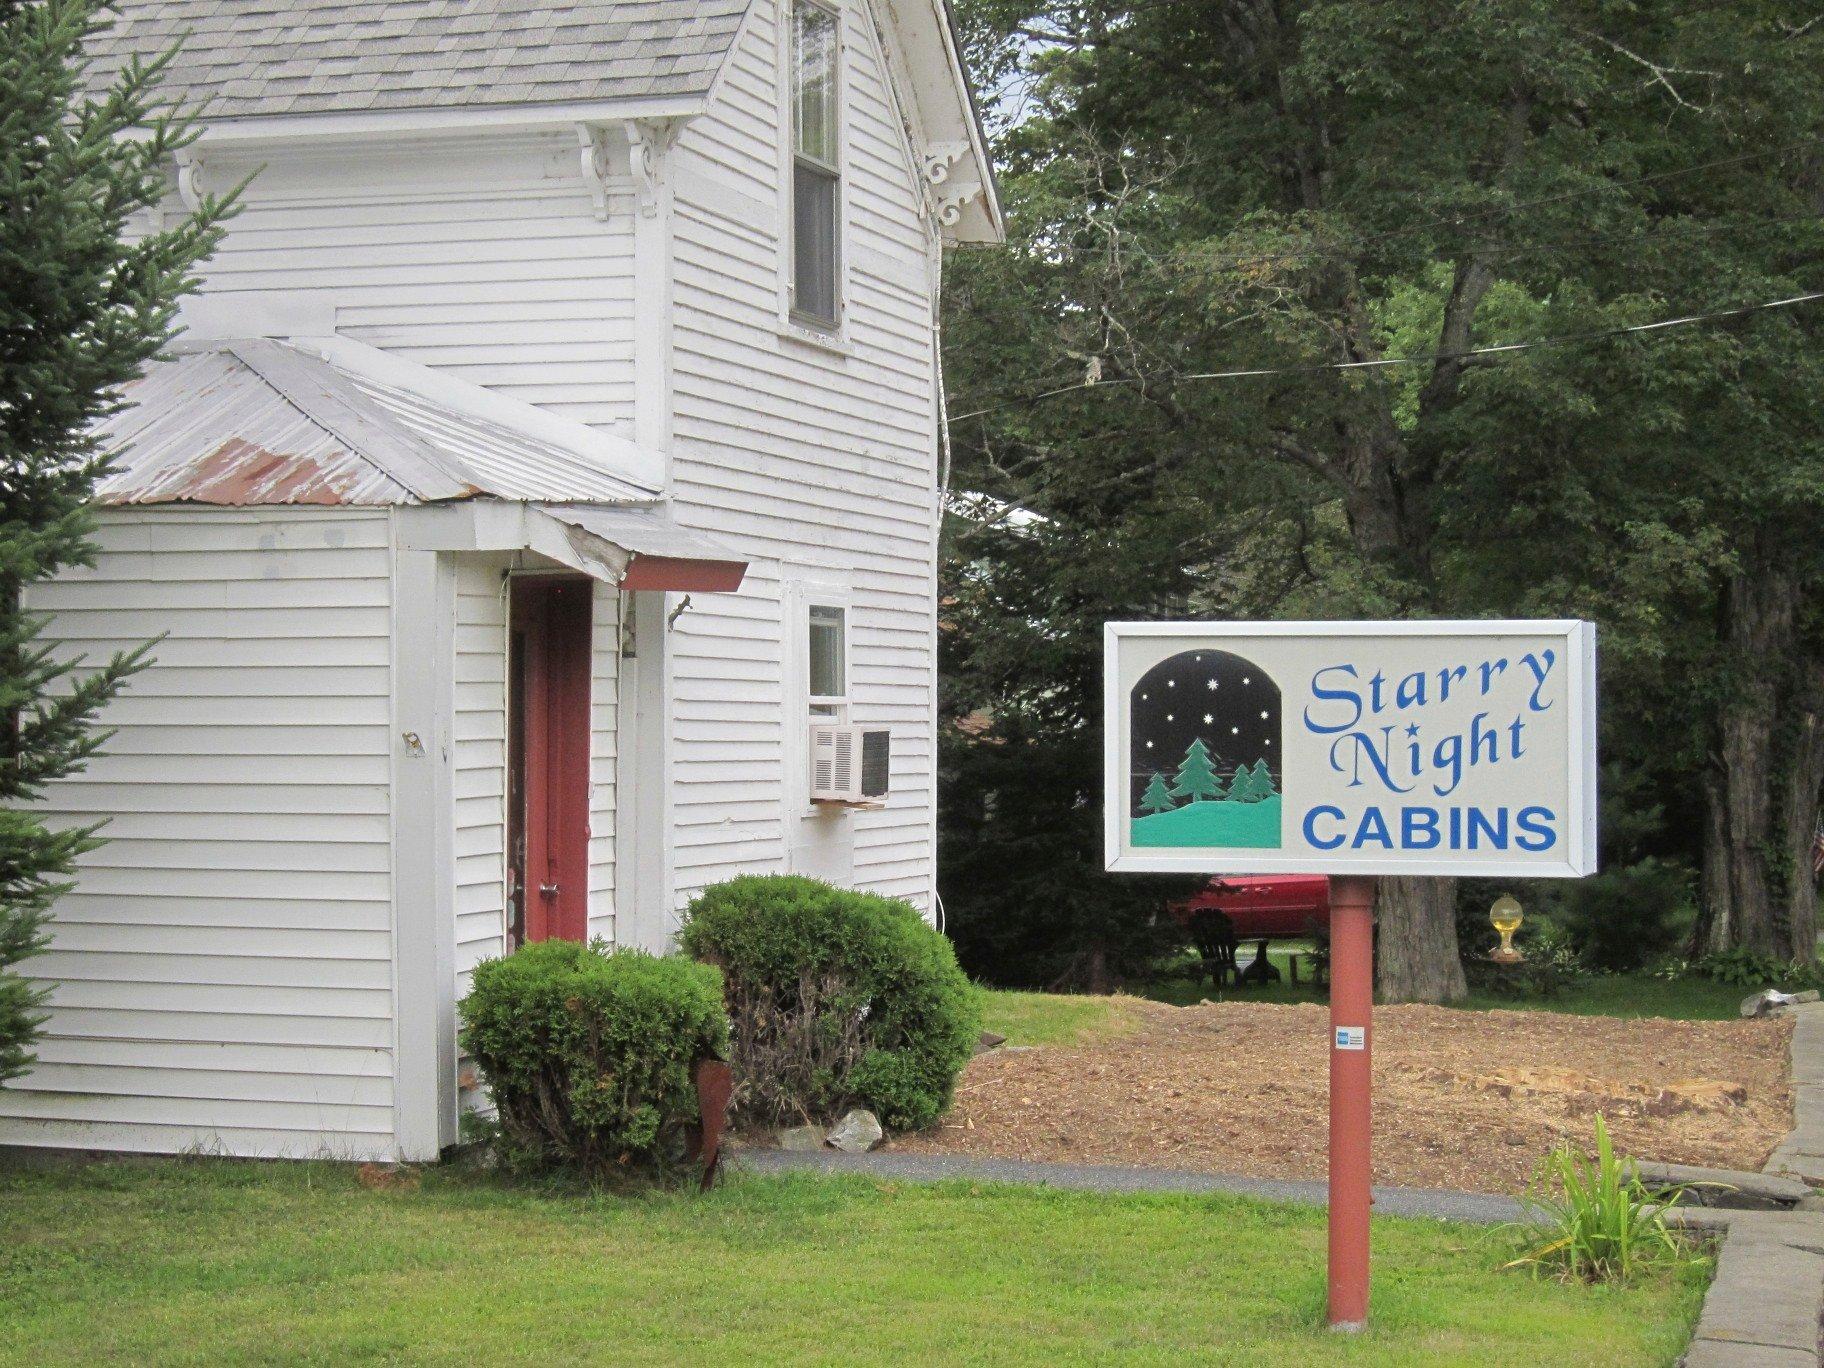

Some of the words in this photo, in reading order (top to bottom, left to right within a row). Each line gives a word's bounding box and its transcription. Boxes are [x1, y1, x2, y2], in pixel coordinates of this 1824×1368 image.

[1303, 649, 1555, 734] Starry
[1330, 712, 1527, 797] Night
[1303, 805, 1557, 852] CABINS
